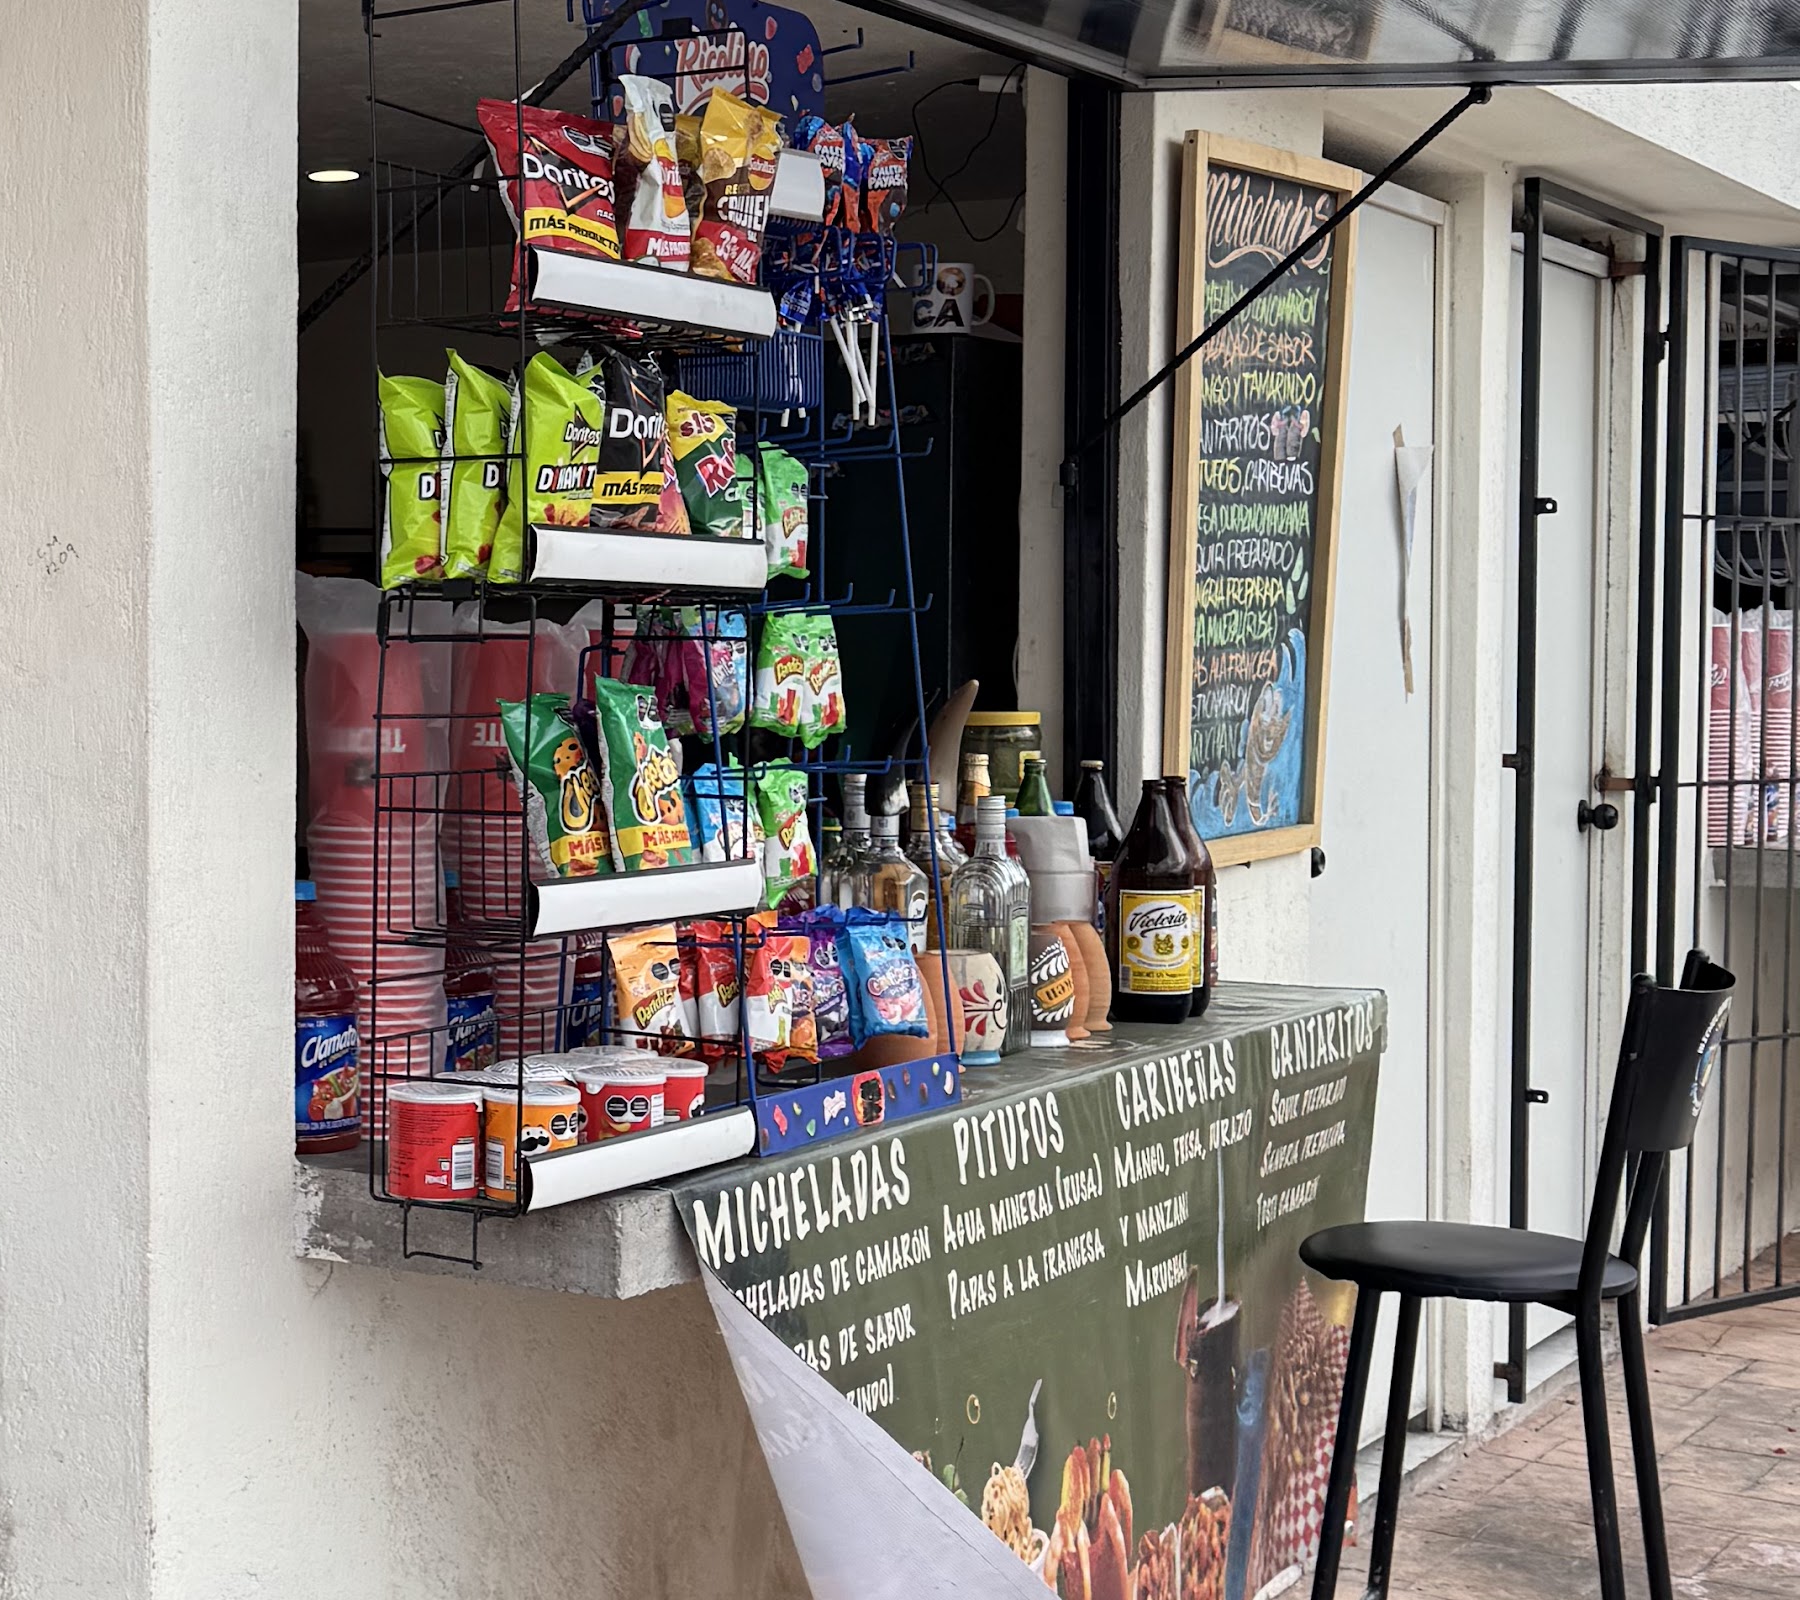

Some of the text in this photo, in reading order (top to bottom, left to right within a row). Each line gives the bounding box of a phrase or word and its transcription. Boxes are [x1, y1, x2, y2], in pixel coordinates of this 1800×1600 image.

[1242, 369, 1316, 405] TAMARINDO
[565, 422, 601, 447] Doritos
[609, 407, 666, 440] Dorit
[538, 464, 596, 492] DINAMIT
[1129, 904, 1188, 937] Victoria
[301, 1024, 360, 1068] Clamato
[1271, 999, 1373, 1080] CANTARITOS
[1115, 1038, 1237, 1130] CARIBEÑAS
[953, 1091, 1064, 1185] PITUFOS
[1114, 1141, 1170, 1188] MANGO,
[693, 1137, 910, 1269] MICHELADAS
[943, 1204, 986, 1253] AGUA
[990, 1183, 1053, 1236] MINERAL
[1119, 1215, 1129, 1247] Y
[830, 1254, 851, 1296] DE
[855, 1225, 931, 1286] CAMARÓN
[948, 1227, 1106, 1320] PAPAS A LA FRANCESA
[839, 1324, 858, 1365] DE
[865, 1303, 916, 1354] SABOR
